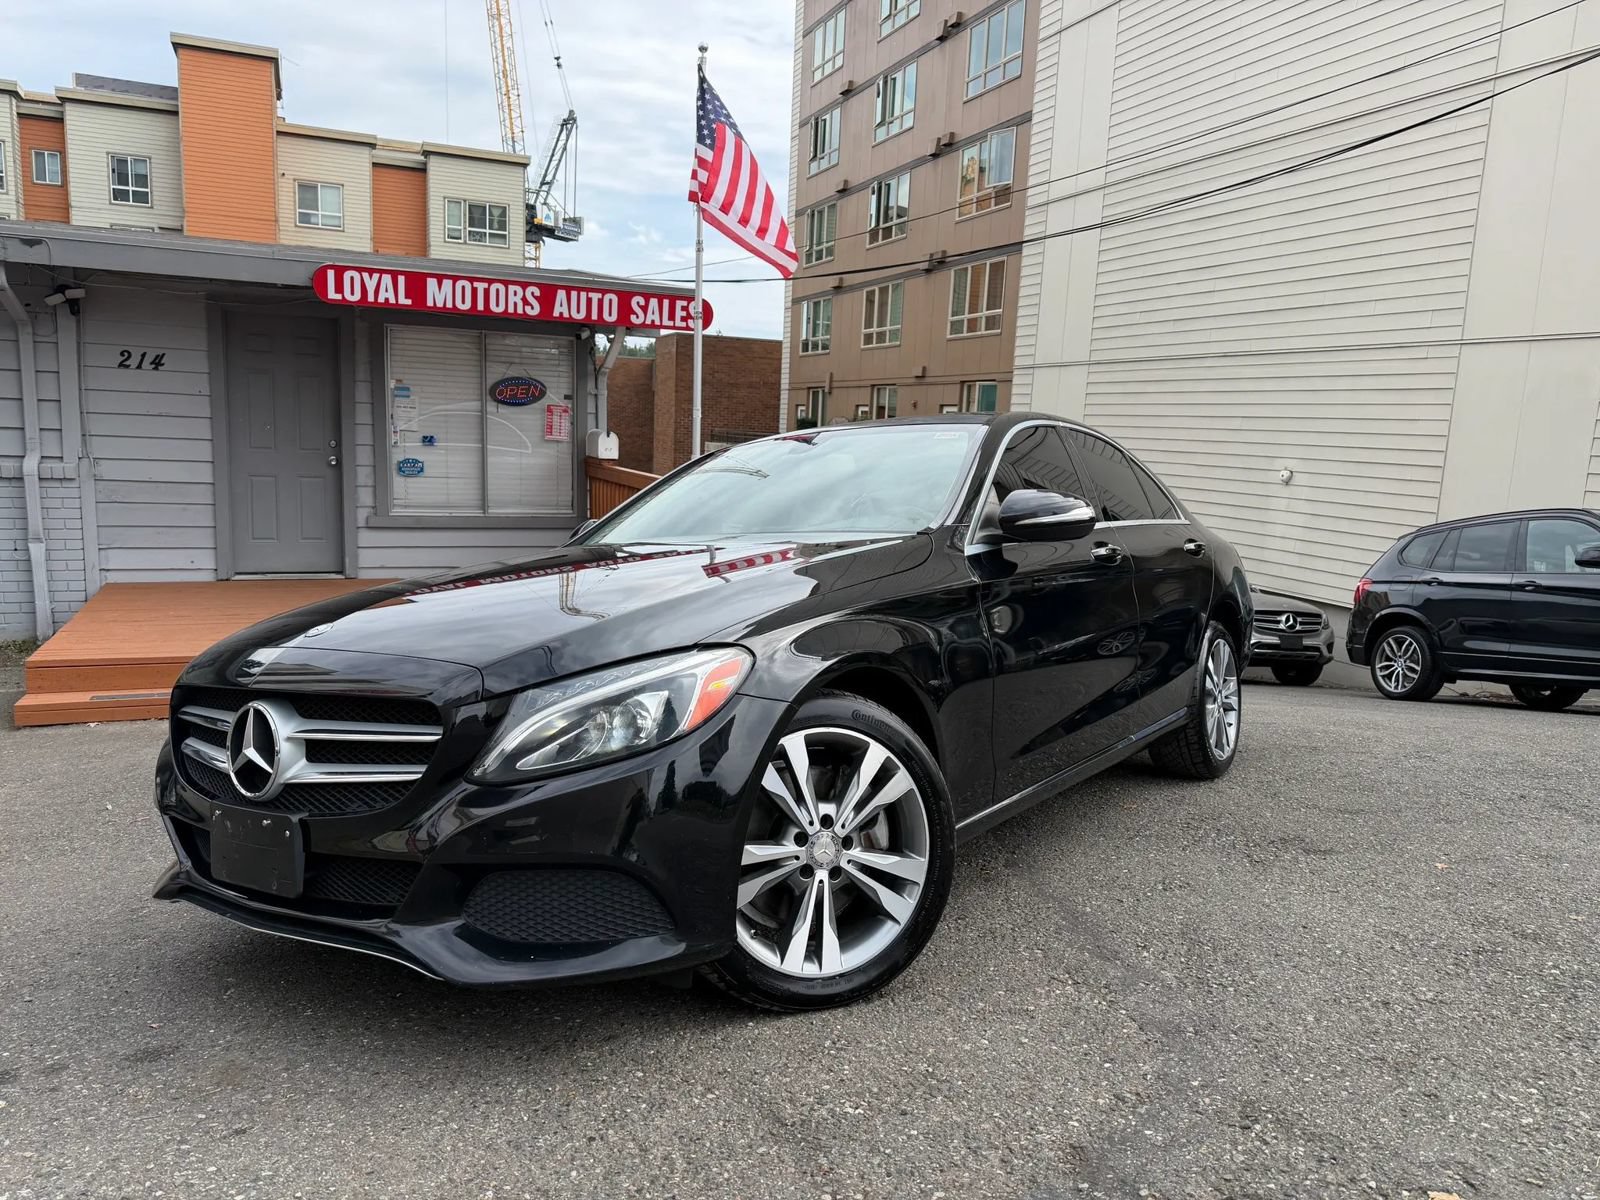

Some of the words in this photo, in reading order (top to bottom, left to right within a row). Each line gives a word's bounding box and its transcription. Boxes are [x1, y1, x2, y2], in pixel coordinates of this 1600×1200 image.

[327, 269, 412, 305] LOYAL
[426, 277, 541, 317] MOTORS
[552, 288, 619, 323] AUTO
[117, 349, 167, 371] 214
[495, 384, 542, 400] OPEN
